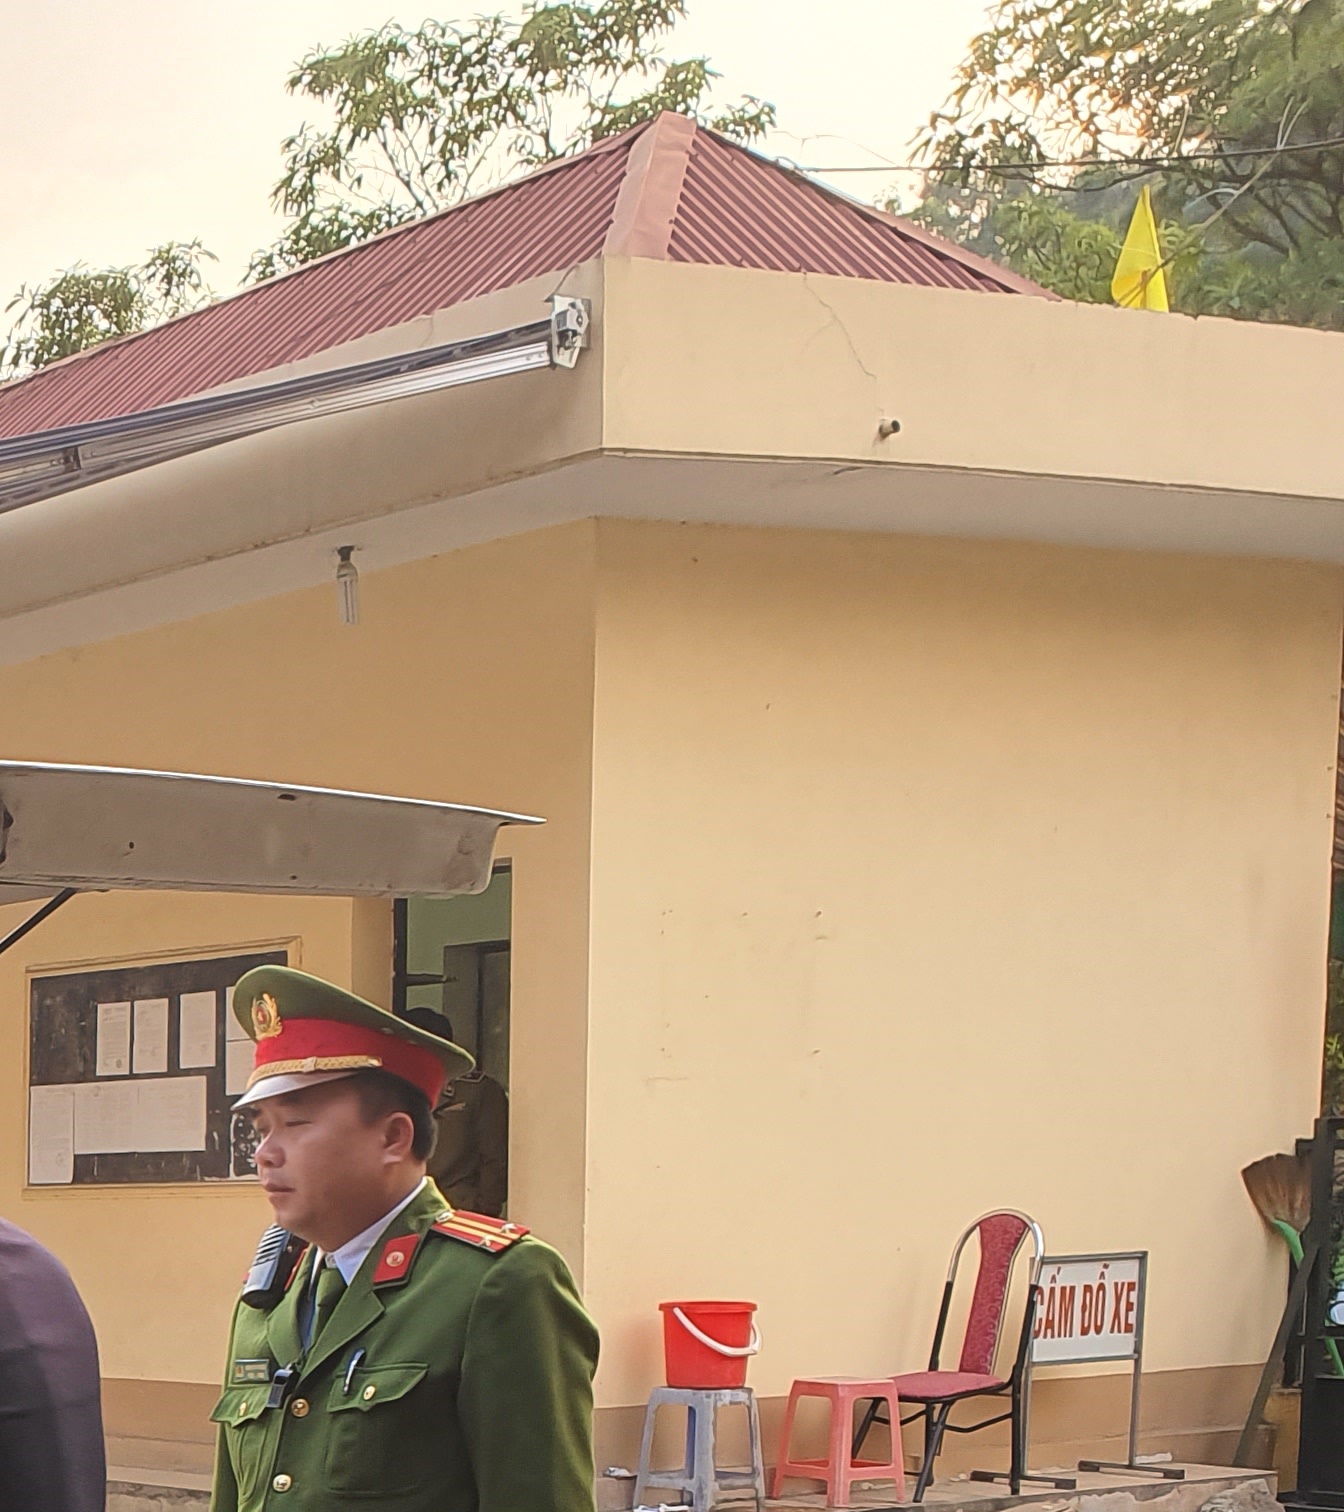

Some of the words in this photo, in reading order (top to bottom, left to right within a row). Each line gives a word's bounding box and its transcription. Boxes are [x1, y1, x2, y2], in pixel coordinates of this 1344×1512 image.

[1032, 1266, 1076, 1340] CẤM
[1080, 1263, 1109, 1336] ĐỖ
[1109, 1281, 1136, 1334] XE
